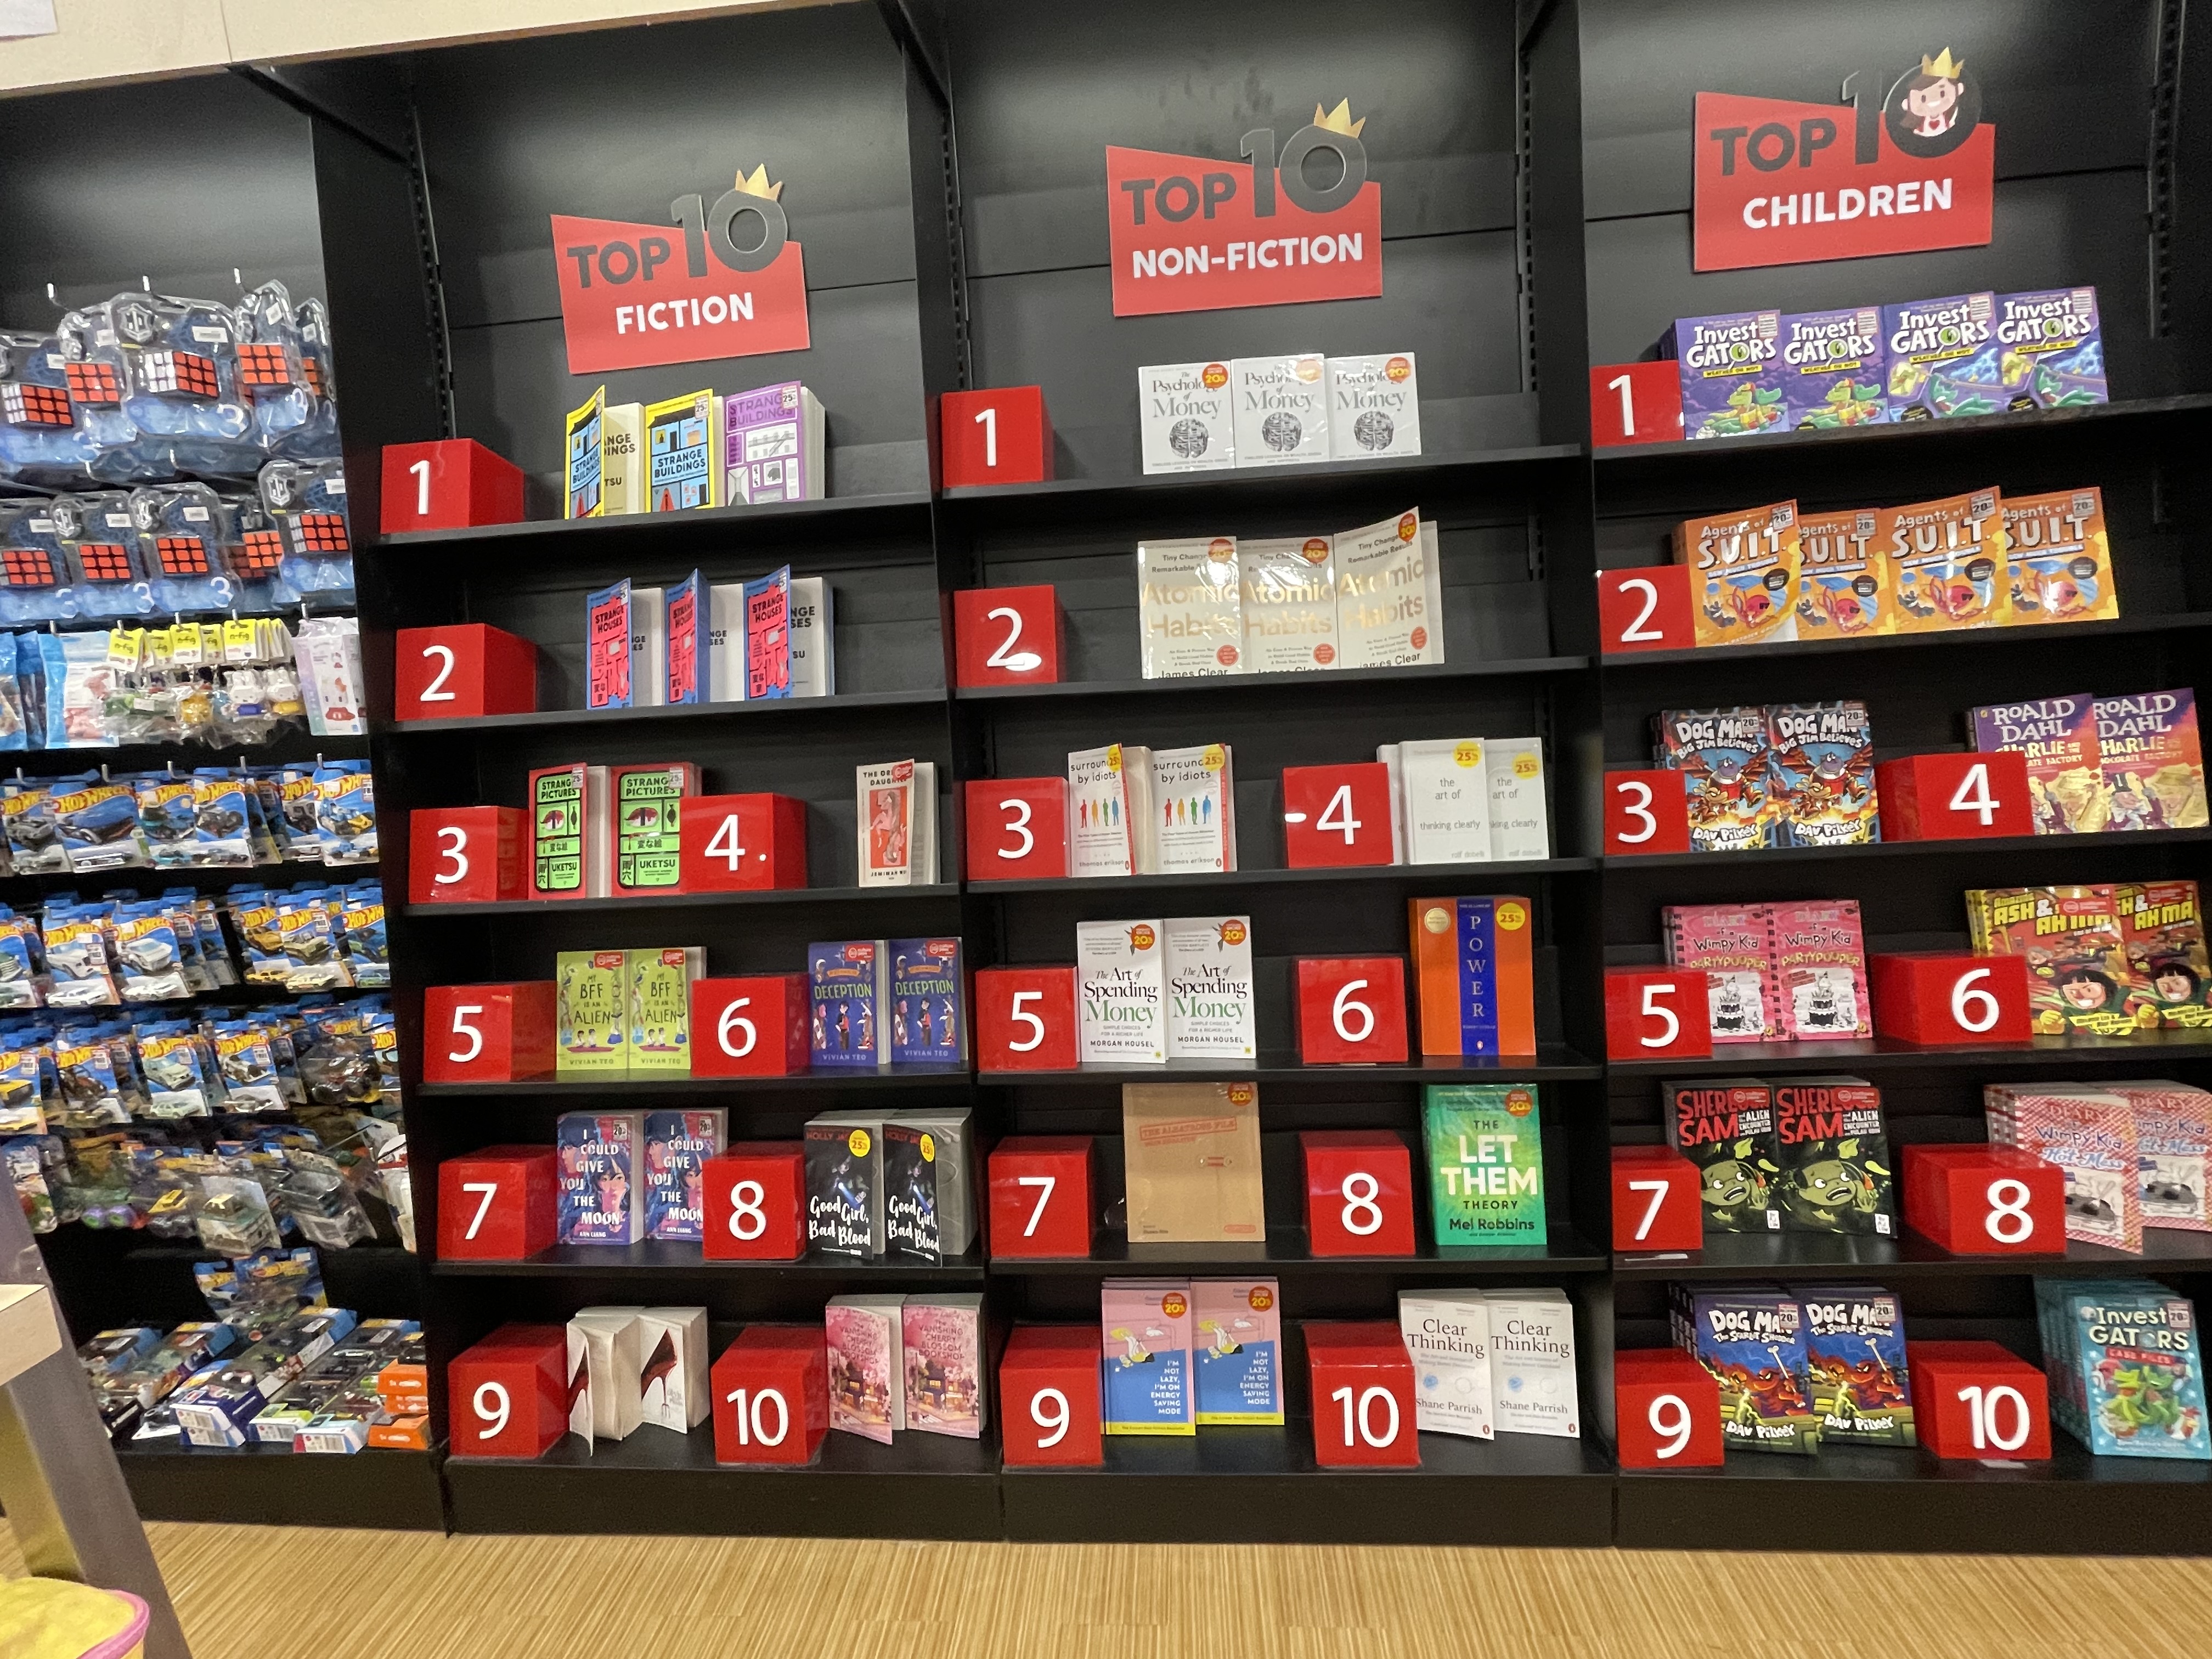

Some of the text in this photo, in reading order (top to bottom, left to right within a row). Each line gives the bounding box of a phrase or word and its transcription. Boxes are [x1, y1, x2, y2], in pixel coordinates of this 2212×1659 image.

[1711, 65, 1981, 176] TOP 10
[1121, 123, 1367, 225] TOP 10
[1743, 178, 1952, 229] CHILDREN
[567, 189, 788, 289] TOP 10
[1133, 233, 1362, 279] NON-FICTION
[616, 292, 754, 334] FICTION
[1899, 304, 1970, 330] Invest
[2004, 297, 2072, 320] Invest
[1694, 322, 1758, 345] Invest
[1891, 320, 1990, 353] GATORS
[1997, 314, 2091, 344] GATORS
[1686, 338, 1776, 368] GATORS
[1153, 397, 1222, 419] Money
[1609, 374, 1635, 436] 1
[975, 408, 996, 466] 1
[654, 459, 706, 478] BUILDINGS
[658, 449, 702, 467] STRANGE
[409, 460, 430, 515] 1
[1894, 510, 1948, 528] Agents
[752, 595, 783, 613] STRANGE
[755, 607, 782, 622] HOUSES
[1618, 578, 1663, 642] 2
[987, 607, 1025, 667] 2
[1395, 653, 1420, 665] Clear
[420, 645, 455, 702] 2
[1993, 699, 2076, 726] ROALD
[1778, 714, 1857, 739] DOG MA
[2001, 719, 2072, 743] DAHL
[627, 777, 668, 787] STRANG
[1161, 771, 1211, 783] by idiots
[1440, 778, 1454, 787] the
[1452, 789, 1461, 799] of
[1949, 763, 2001, 826] 4
[1316, 785, 1362, 845] 4
[1420, 820, 1481, 831] thinking clearly
[1616, 781, 1658, 844] 3
[997, 799, 1035, 859] 3
[1795, 822, 1822, 837] DAV
[435, 826, 468, 884] 3
[704, 814, 746, 871] 4
[640, 859, 675, 868] UKETSU
[1994, 899, 2052, 926] ASH &
[1694, 935, 1759, 952] Wimpy Kid
[1096, 967, 1143, 981] The Art of
[1467, 916, 1486, 1017] POWER
[580, 983, 603, 999] BFF
[814, 984, 872, 999] DECEPTION
[895, 980, 954, 996] DECEPTION
[1084, 981, 1158, 1003] Spending
[1172, 978, 1247, 999] Spending
[1950, 968, 2001, 1033] 6
[574, 1011, 611, 1025] ALIEN
[1008, 991, 1045, 1052] 5
[1085, 1000, 1157, 1029] Money
[1173, 996, 1246, 1024] Money
[1332, 979, 1375, 1042] 6
[1640, 984, 1680, 1048] 5
[448, 1005, 483, 1063] 5
[717, 997, 757, 1058] 6
[1474, 1120, 1499, 1129] THE
[1779, 1112, 1843, 1144] SAM
[1850, 1111, 1878, 1122] ALIEN
[583, 1130, 587, 1139] I
[2035, 1126, 2094, 1146] Wimpy
[580, 1144, 619, 1155] COULD
[1459, 1135, 1517, 1163] LET
[577, 1161, 604, 1173] GIVE
[560, 1178, 584, 1190] YOU
[1440, 1167, 1537, 1195] THEM
[462, 1182, 498, 1240] 7
[573, 1196, 594, 1206] THE
[728, 1180, 767, 1240] 8
[810, 1195, 840, 1218] Good
[1018, 1176, 1056, 1237] 7
[1341, 1172, 1383, 1235] 8
[1463, 1200, 1517, 1210] THEORY
[1629, 1180, 1670, 1241] 7
[1984, 1178, 2034, 1244] 8
[581, 1212, 620, 1224] MOON
[1449, 1218, 1534, 1230] Mel Robbins
[809, 1220, 871, 1246] Bad Blood
[1423, 1319, 1467, 1336] Clear
[1508, 1320, 1552, 1336] Clear
[1708, 1310, 1792, 1334] DOG MA
[2096, 1307, 2167, 1325] Invest
[919, 1325, 963, 1335] VANISHING
[2089, 1325, 2190, 1350] GATORS
[1407, 1334, 1485, 1359] Thinking
[1491, 1336, 1570, 1358] Thinking
[473, 1381, 510, 1440] 9
[726, 1389, 789, 1447] 10
[1030, 1387, 1070, 1448] 9
[1331, 1386, 1400, 1449] 10
[1500, 1401, 1568, 1414] Shane Parrish
[1957, 1385, 2031, 1452] 10
[1647, 1394, 1692, 1460] 9
